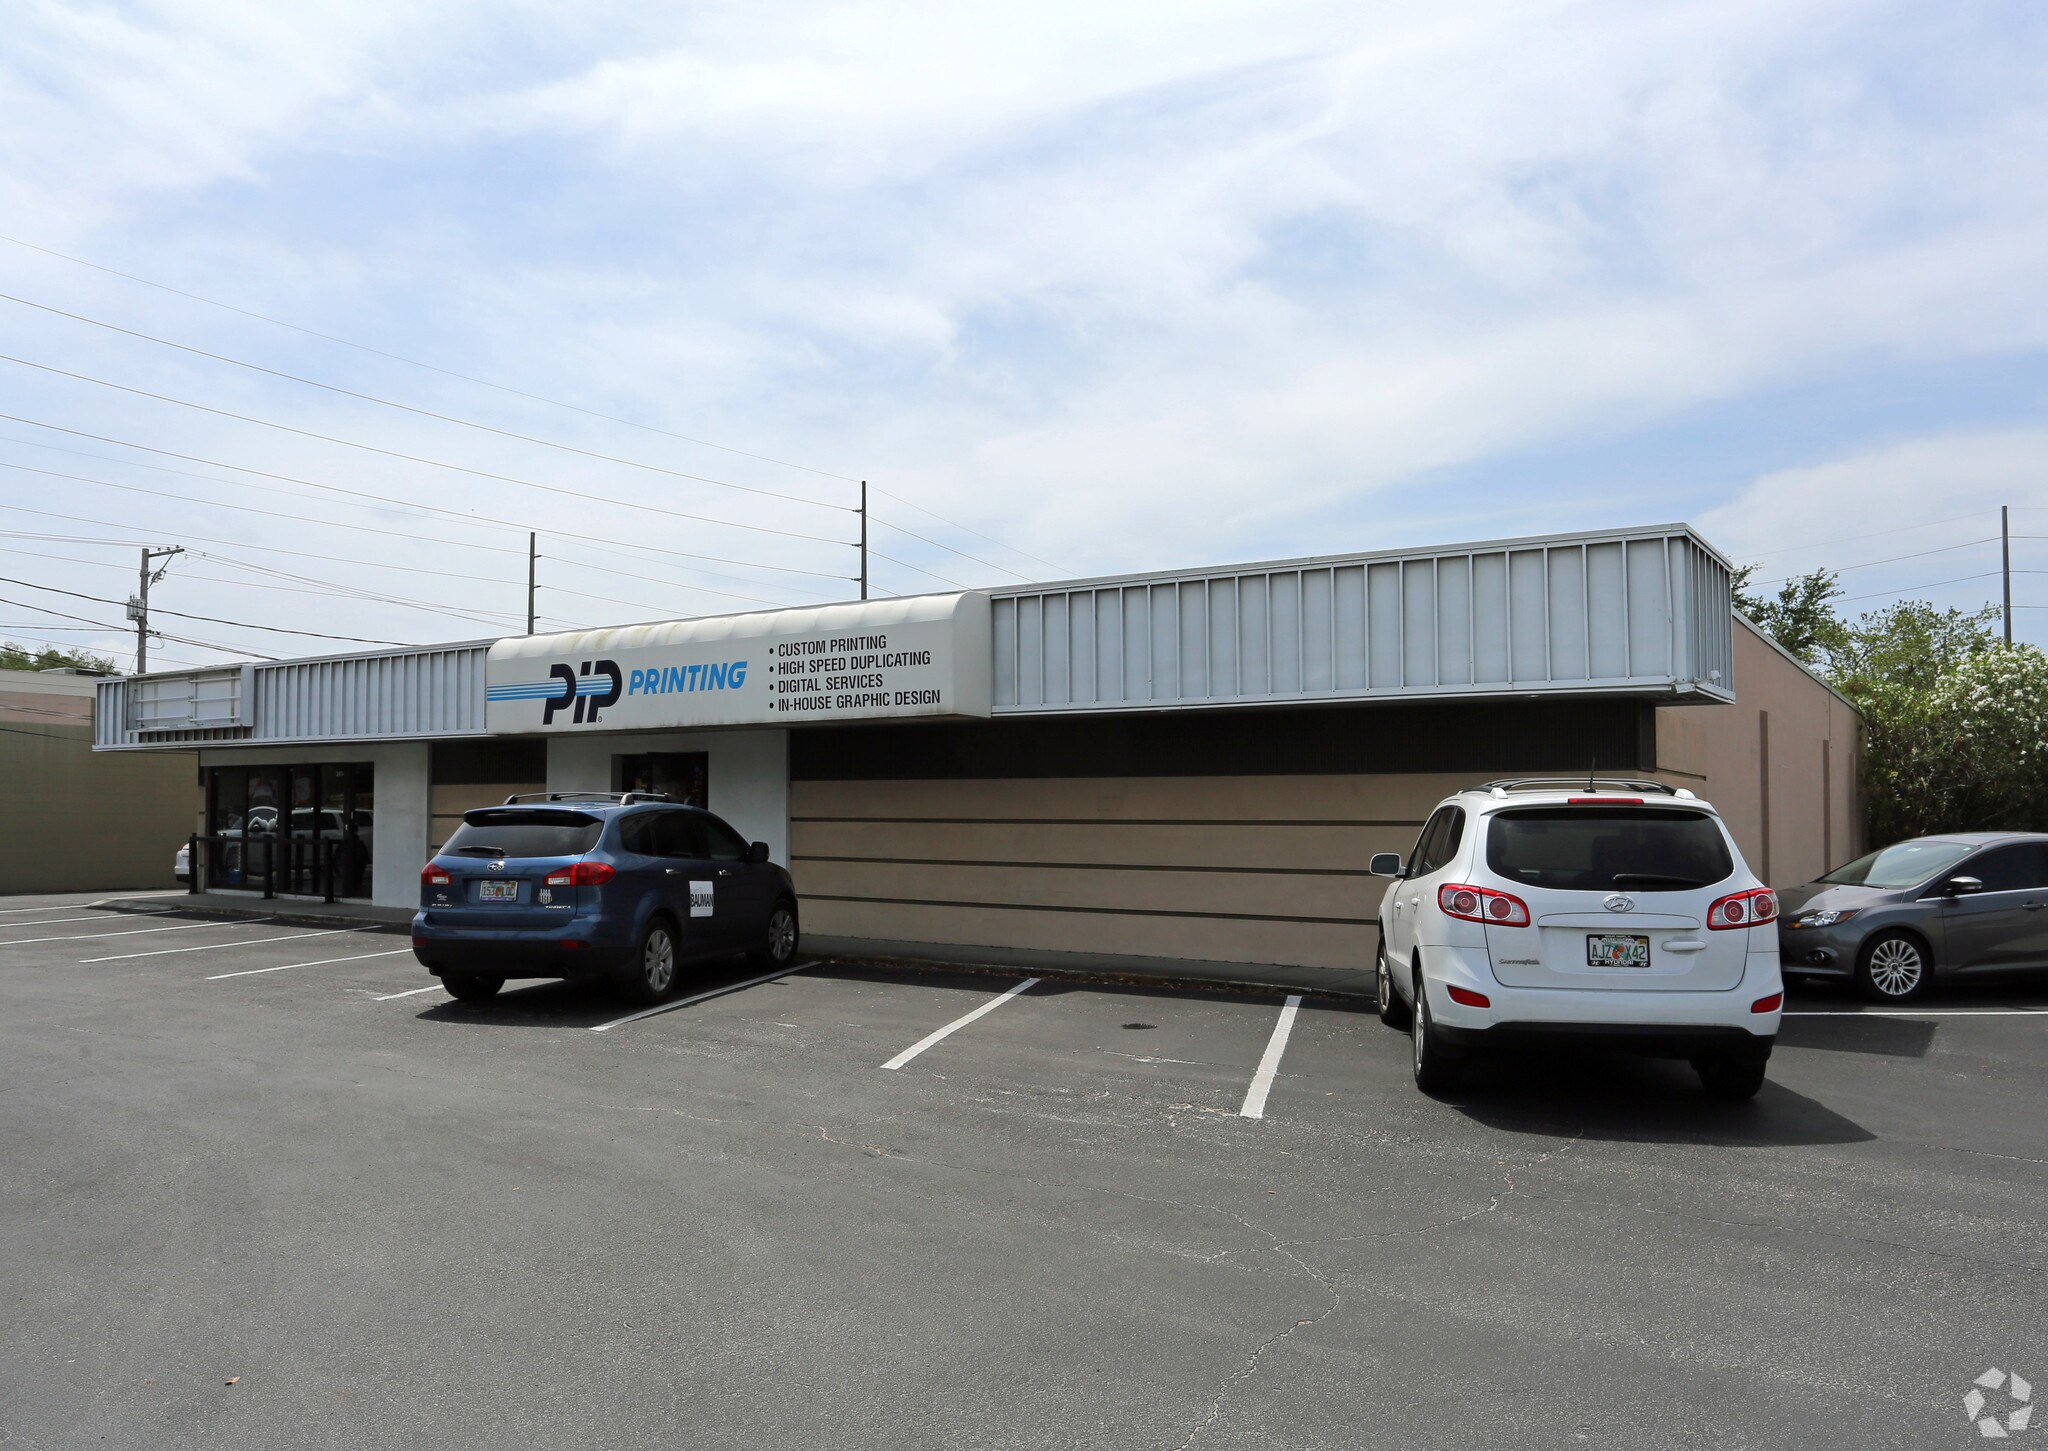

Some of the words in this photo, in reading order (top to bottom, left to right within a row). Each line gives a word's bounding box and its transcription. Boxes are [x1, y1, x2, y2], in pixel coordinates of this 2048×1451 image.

[778, 640, 826, 657] CUSTOM
[830, 634, 887, 653] PRINTING
[778, 660, 805, 675] HIGH
[809, 657, 846, 673] SPEED
[851, 650, 931, 670] DUPLICATING
[628, 661, 747, 695] PRINTING
[778, 678, 821, 693] DIGITAL
[825, 673, 883, 691] SERVICES
[778, 696, 832, 712] IN-HOUSE
[836, 692, 890, 709] GRAPHIC
[894, 689, 941, 706] DESIGN
[690, 893, 714, 907] BAUMAN
